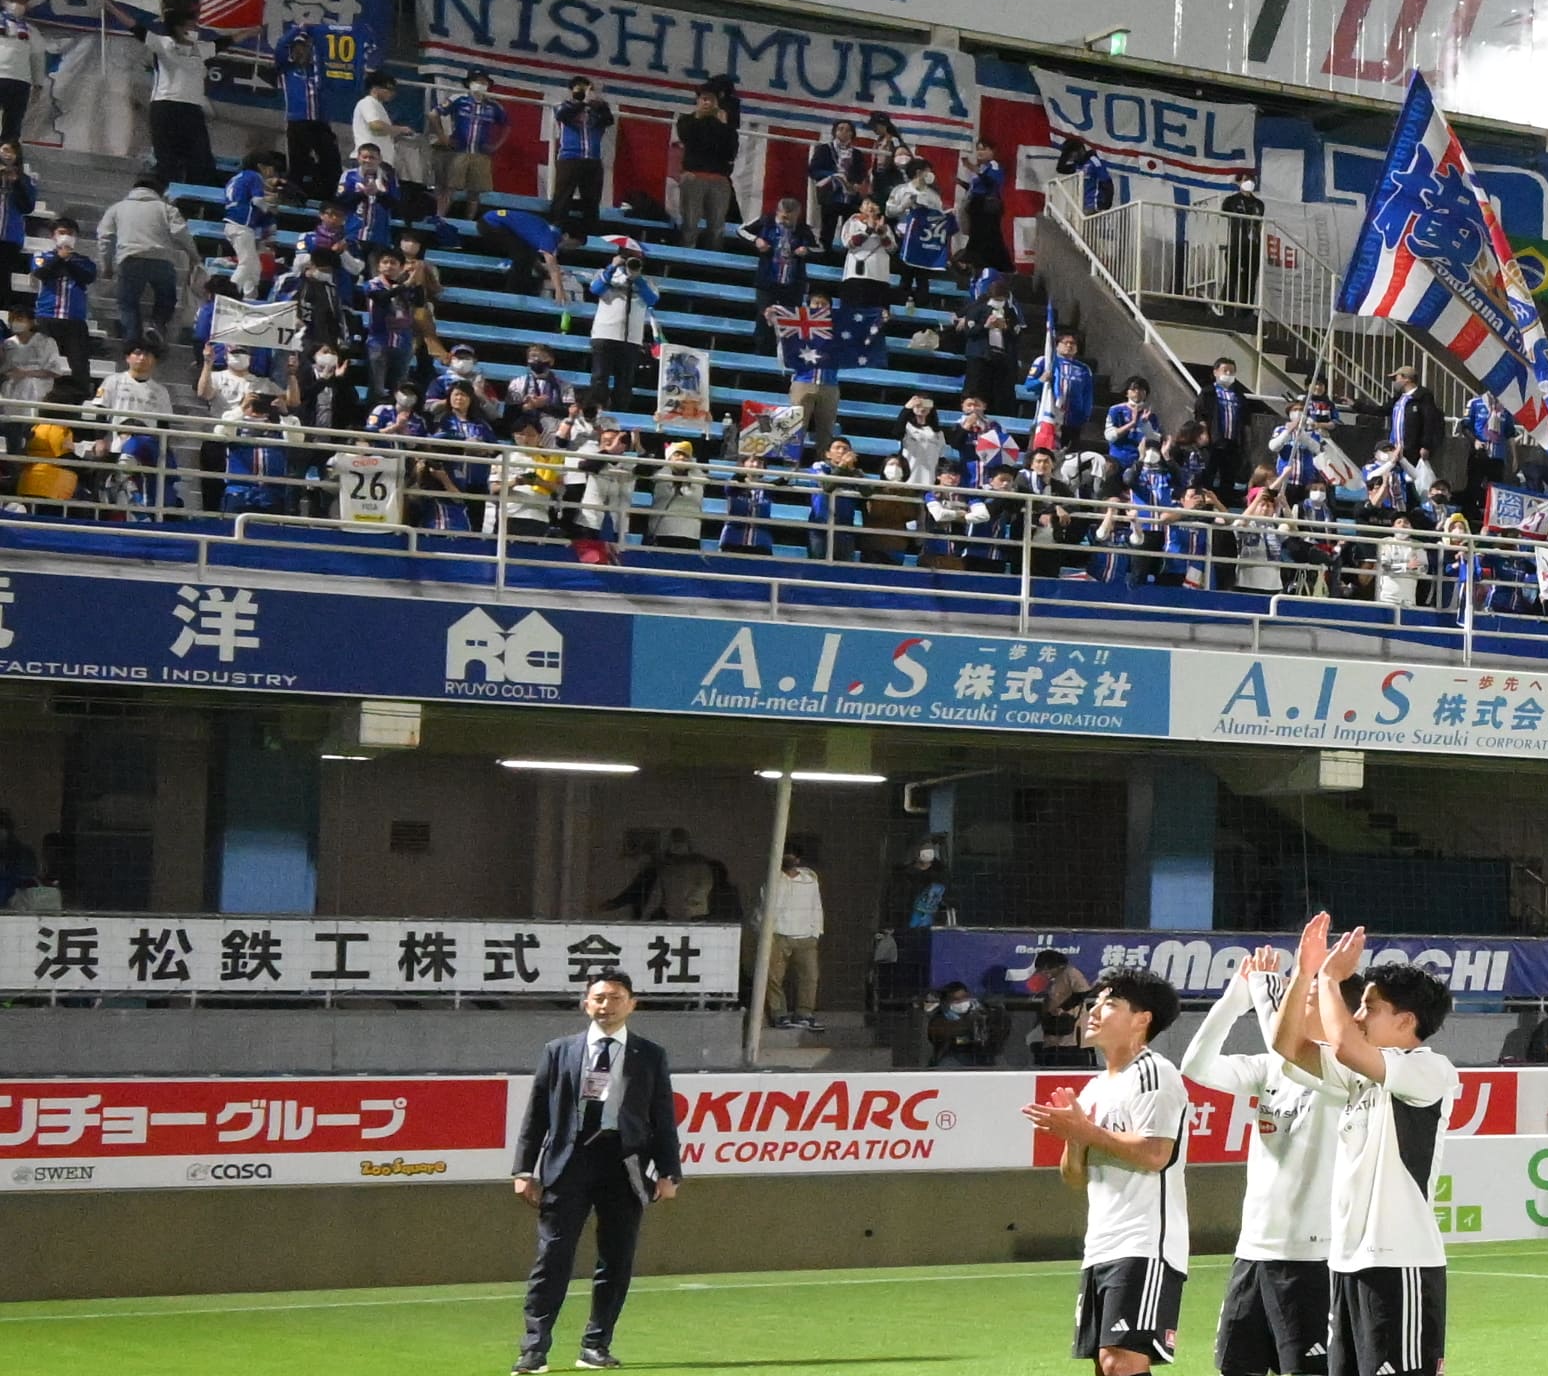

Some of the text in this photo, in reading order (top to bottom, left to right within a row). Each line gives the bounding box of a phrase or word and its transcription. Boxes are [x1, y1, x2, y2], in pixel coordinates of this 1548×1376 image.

[327, 33, 355, 62] 10
[1049, 85, 1247, 161] JOEL
[350, 469, 388, 502] 26
[444, 680, 498, 696] RYUYO
[954, 661, 1133, 709] 株式会社
[691, 683, 1123, 730] Alumi-metal Improve Suzuki CORPORATION
[1213, 718, 1327, 741] Alumi-metal
[1334, 724, 1406, 748] Improve
[1413, 728, 1469, 748] Suzuki
[34, 927, 702, 984] 浜松鉄工株式会社
[715, 1139, 934, 1163] CORPORATION
[34, 1163, 95, 1183] SWEN
